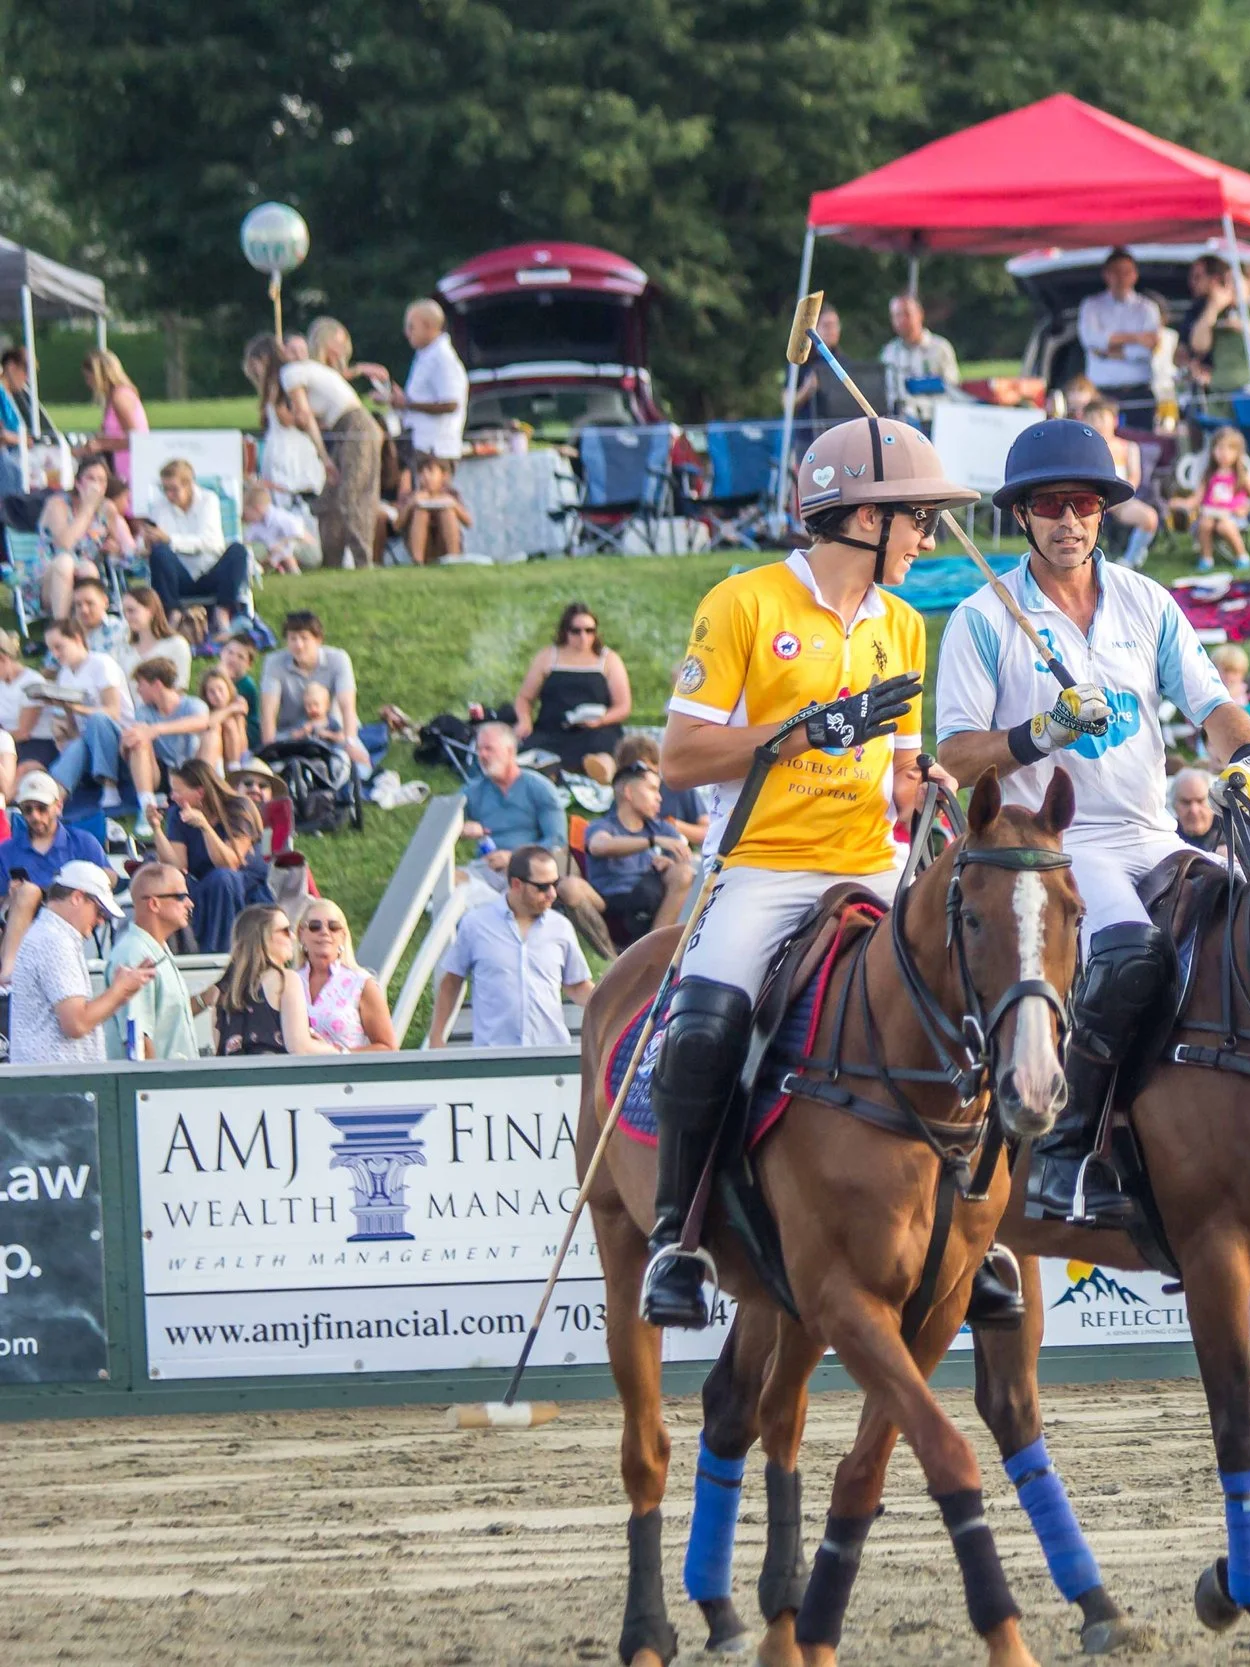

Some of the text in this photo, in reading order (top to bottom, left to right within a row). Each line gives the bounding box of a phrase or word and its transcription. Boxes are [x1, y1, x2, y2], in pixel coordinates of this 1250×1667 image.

[788, 783, 858, 801] POLO TEAM
[158, 1108, 301, 1188] AMJ
[162, 1196, 338, 1228] WEALTH
[168, 1254, 287, 1271] WEALTH
[309, 1245, 521, 1267] MANAGEMENT
[165, 1307, 526, 1349] www.amjfinancial.com
